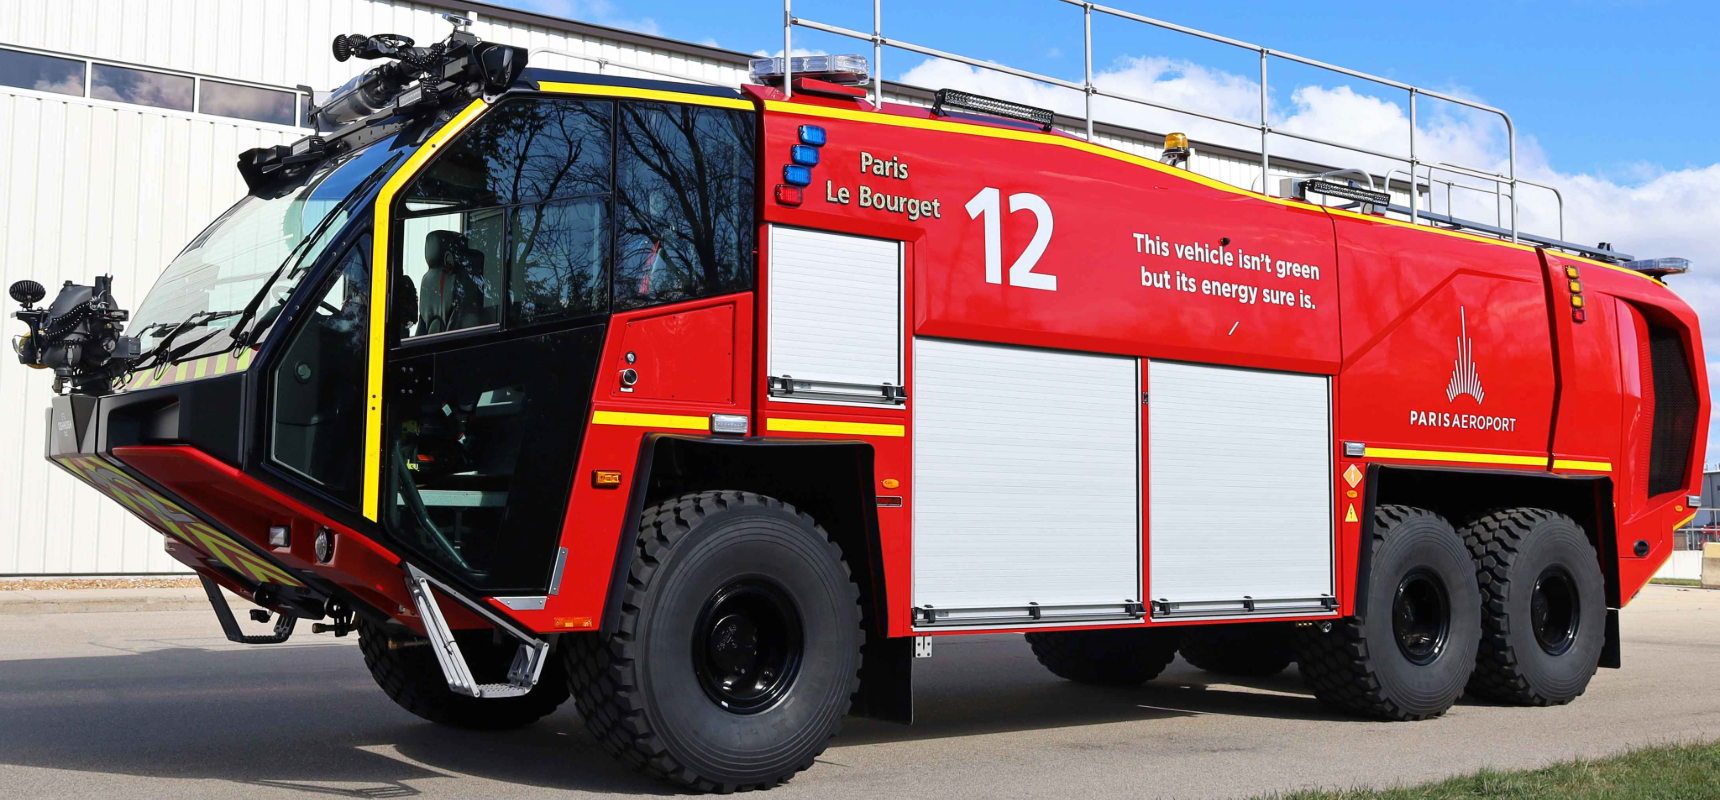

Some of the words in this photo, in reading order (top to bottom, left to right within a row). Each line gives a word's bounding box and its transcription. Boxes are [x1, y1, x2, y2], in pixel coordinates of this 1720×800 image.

[862, 152, 908, 179] Paris
[827, 180, 849, 203] Le
[860, 186, 940, 220] Bourget
[965, 187, 1057, 291] 12
[1133, 233, 1169, 256] This
[1175, 242, 1233, 266] vehicle
[1276, 260, 1319, 280] green
[1141, 266, 1170, 289] but
[1176, 271, 1196, 292] its
[1202, 280, 1257, 304] energy
[1263, 289, 1295, 306] sure
[1300, 289, 1315, 309] is.
